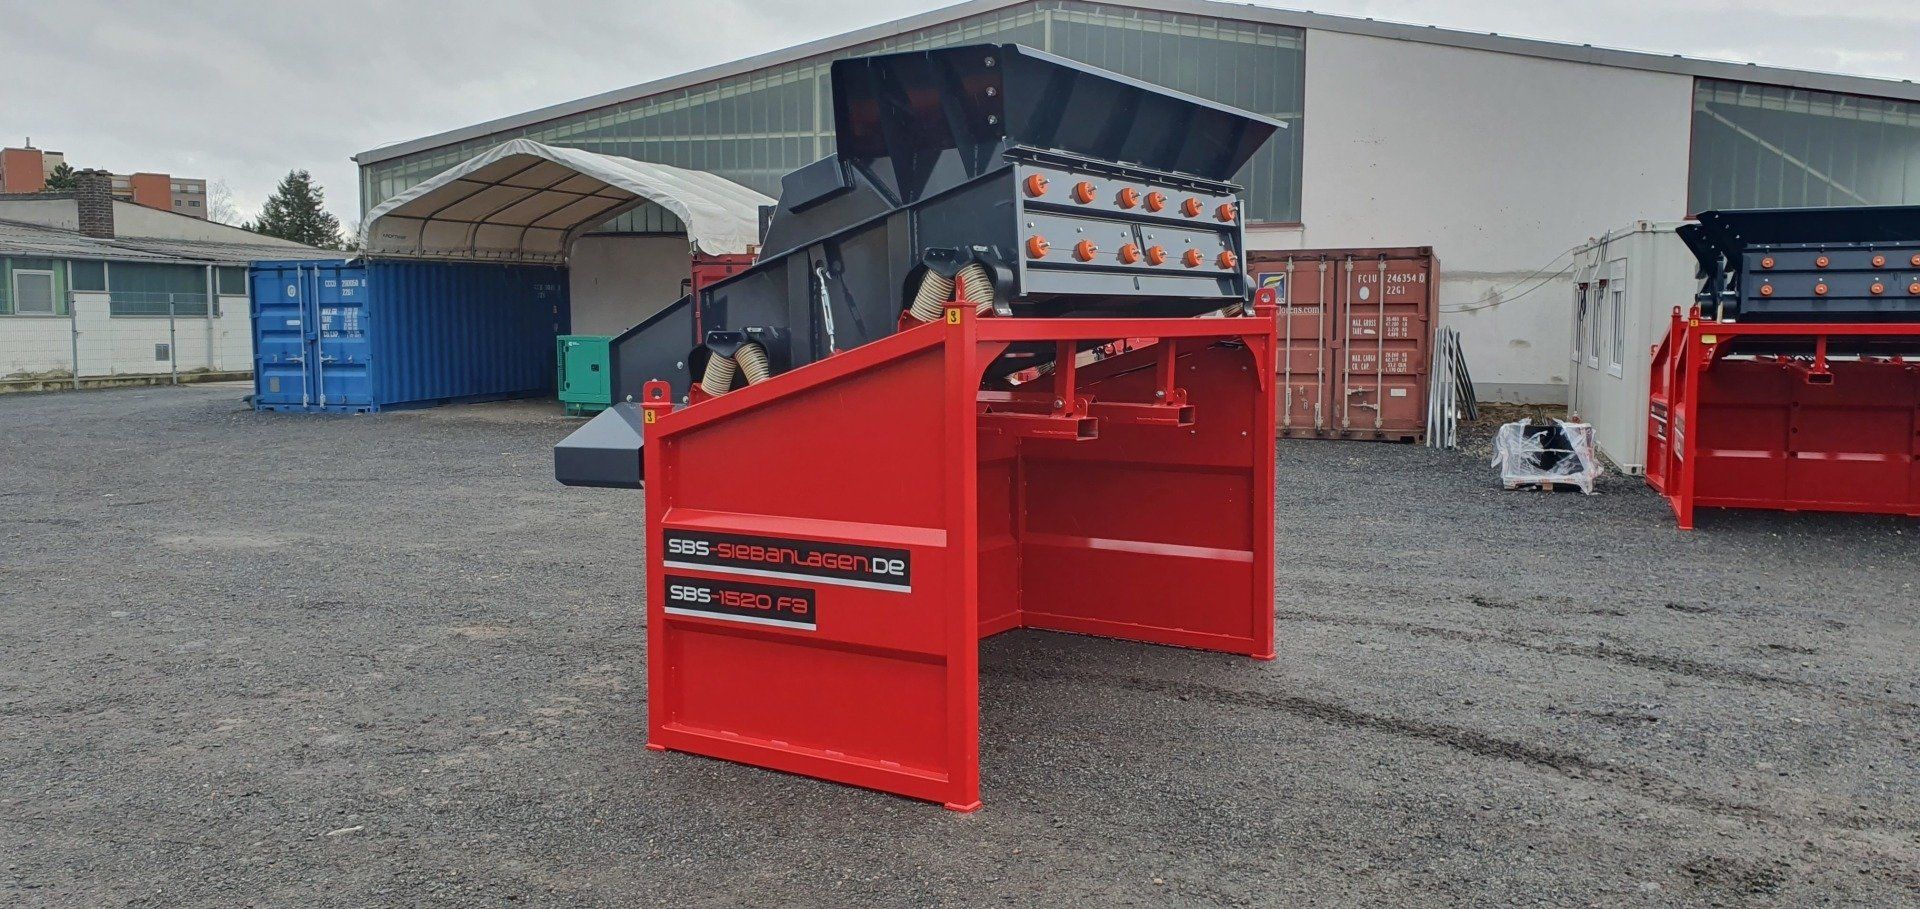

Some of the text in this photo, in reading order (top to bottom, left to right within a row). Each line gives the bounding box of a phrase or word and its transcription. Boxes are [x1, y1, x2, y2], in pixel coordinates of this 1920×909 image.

[1358, 274, 1377, 283] FCIU
[1387, 274, 1416, 283] 246354
[1386, 286, 1405, 295] 22G1
[670, 585, 808, 614] SBS-1520 F3
